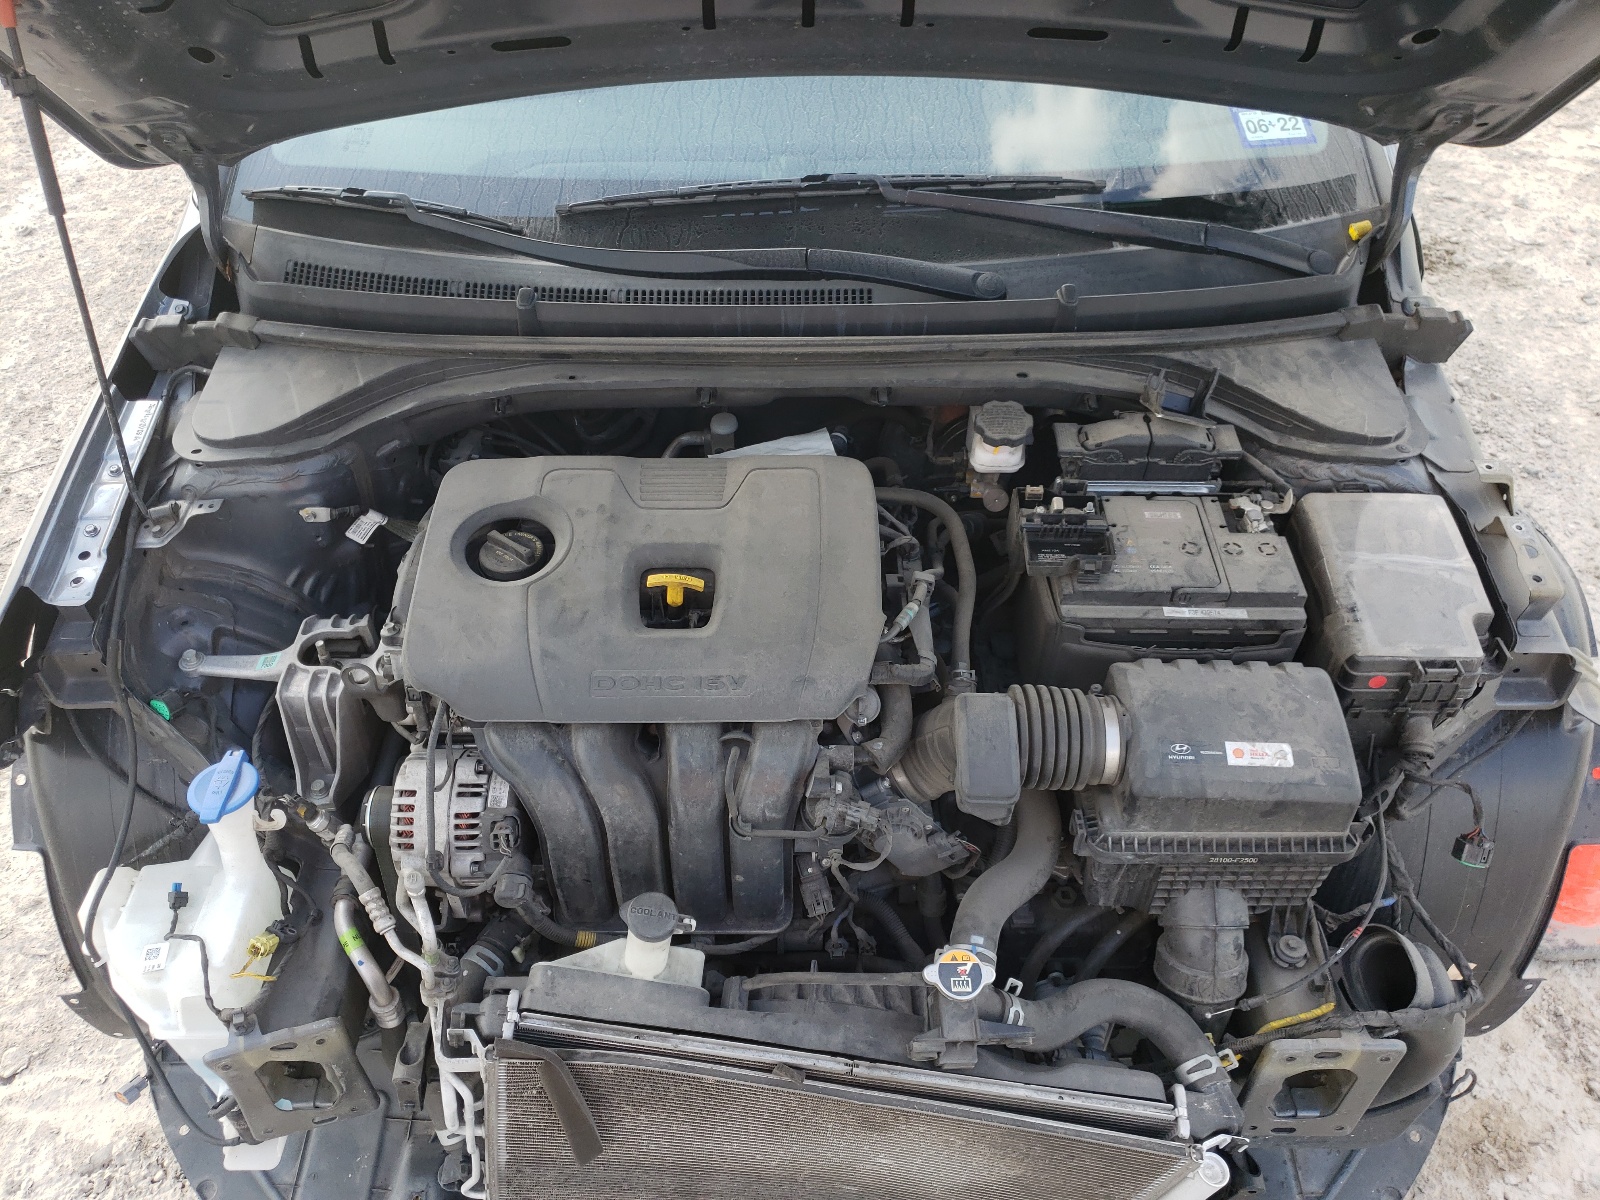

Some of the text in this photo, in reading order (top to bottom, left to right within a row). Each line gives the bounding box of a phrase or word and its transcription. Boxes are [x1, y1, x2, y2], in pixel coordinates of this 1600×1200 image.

[1245, 117, 1302, 134] 06 22
[592, 674, 748, 691] DOHC 16V
[630, 906, 678, 921] COOLANT
